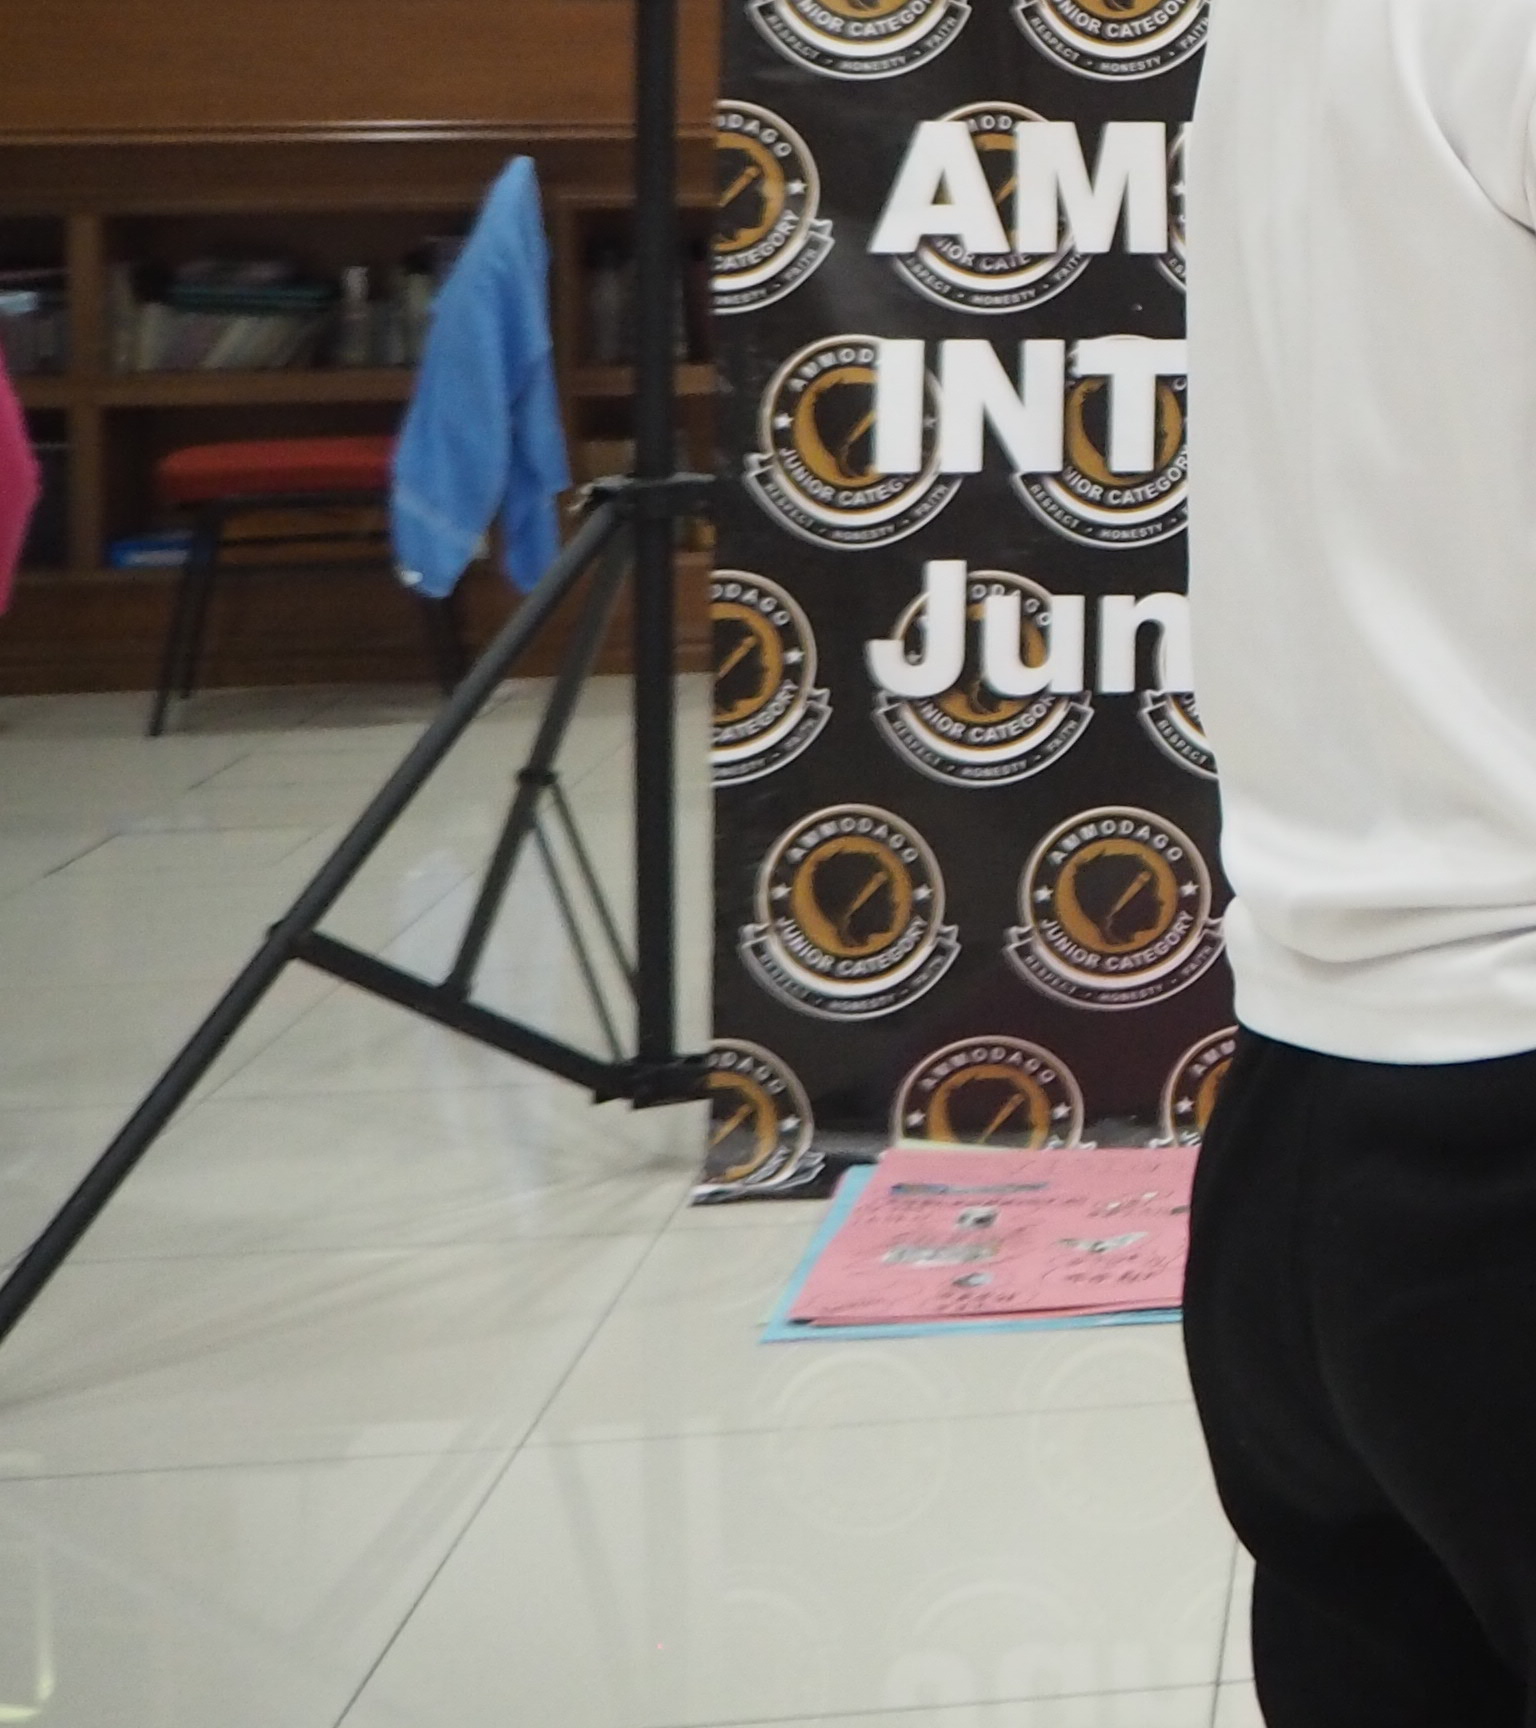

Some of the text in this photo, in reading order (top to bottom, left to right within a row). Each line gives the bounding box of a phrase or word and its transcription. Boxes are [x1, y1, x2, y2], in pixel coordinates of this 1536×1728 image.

[1100, 55, 1162, 72] HONESTY
[869, 120, 1187, 254] AM
[838, 475, 908, 508] CATEG
[1107, 446, 1188, 505] CATEGOR
[1049, 819, 1183, 865] AMMODAGO
[1041, 910, 1195, 972] JUNIOR CATEGORY
